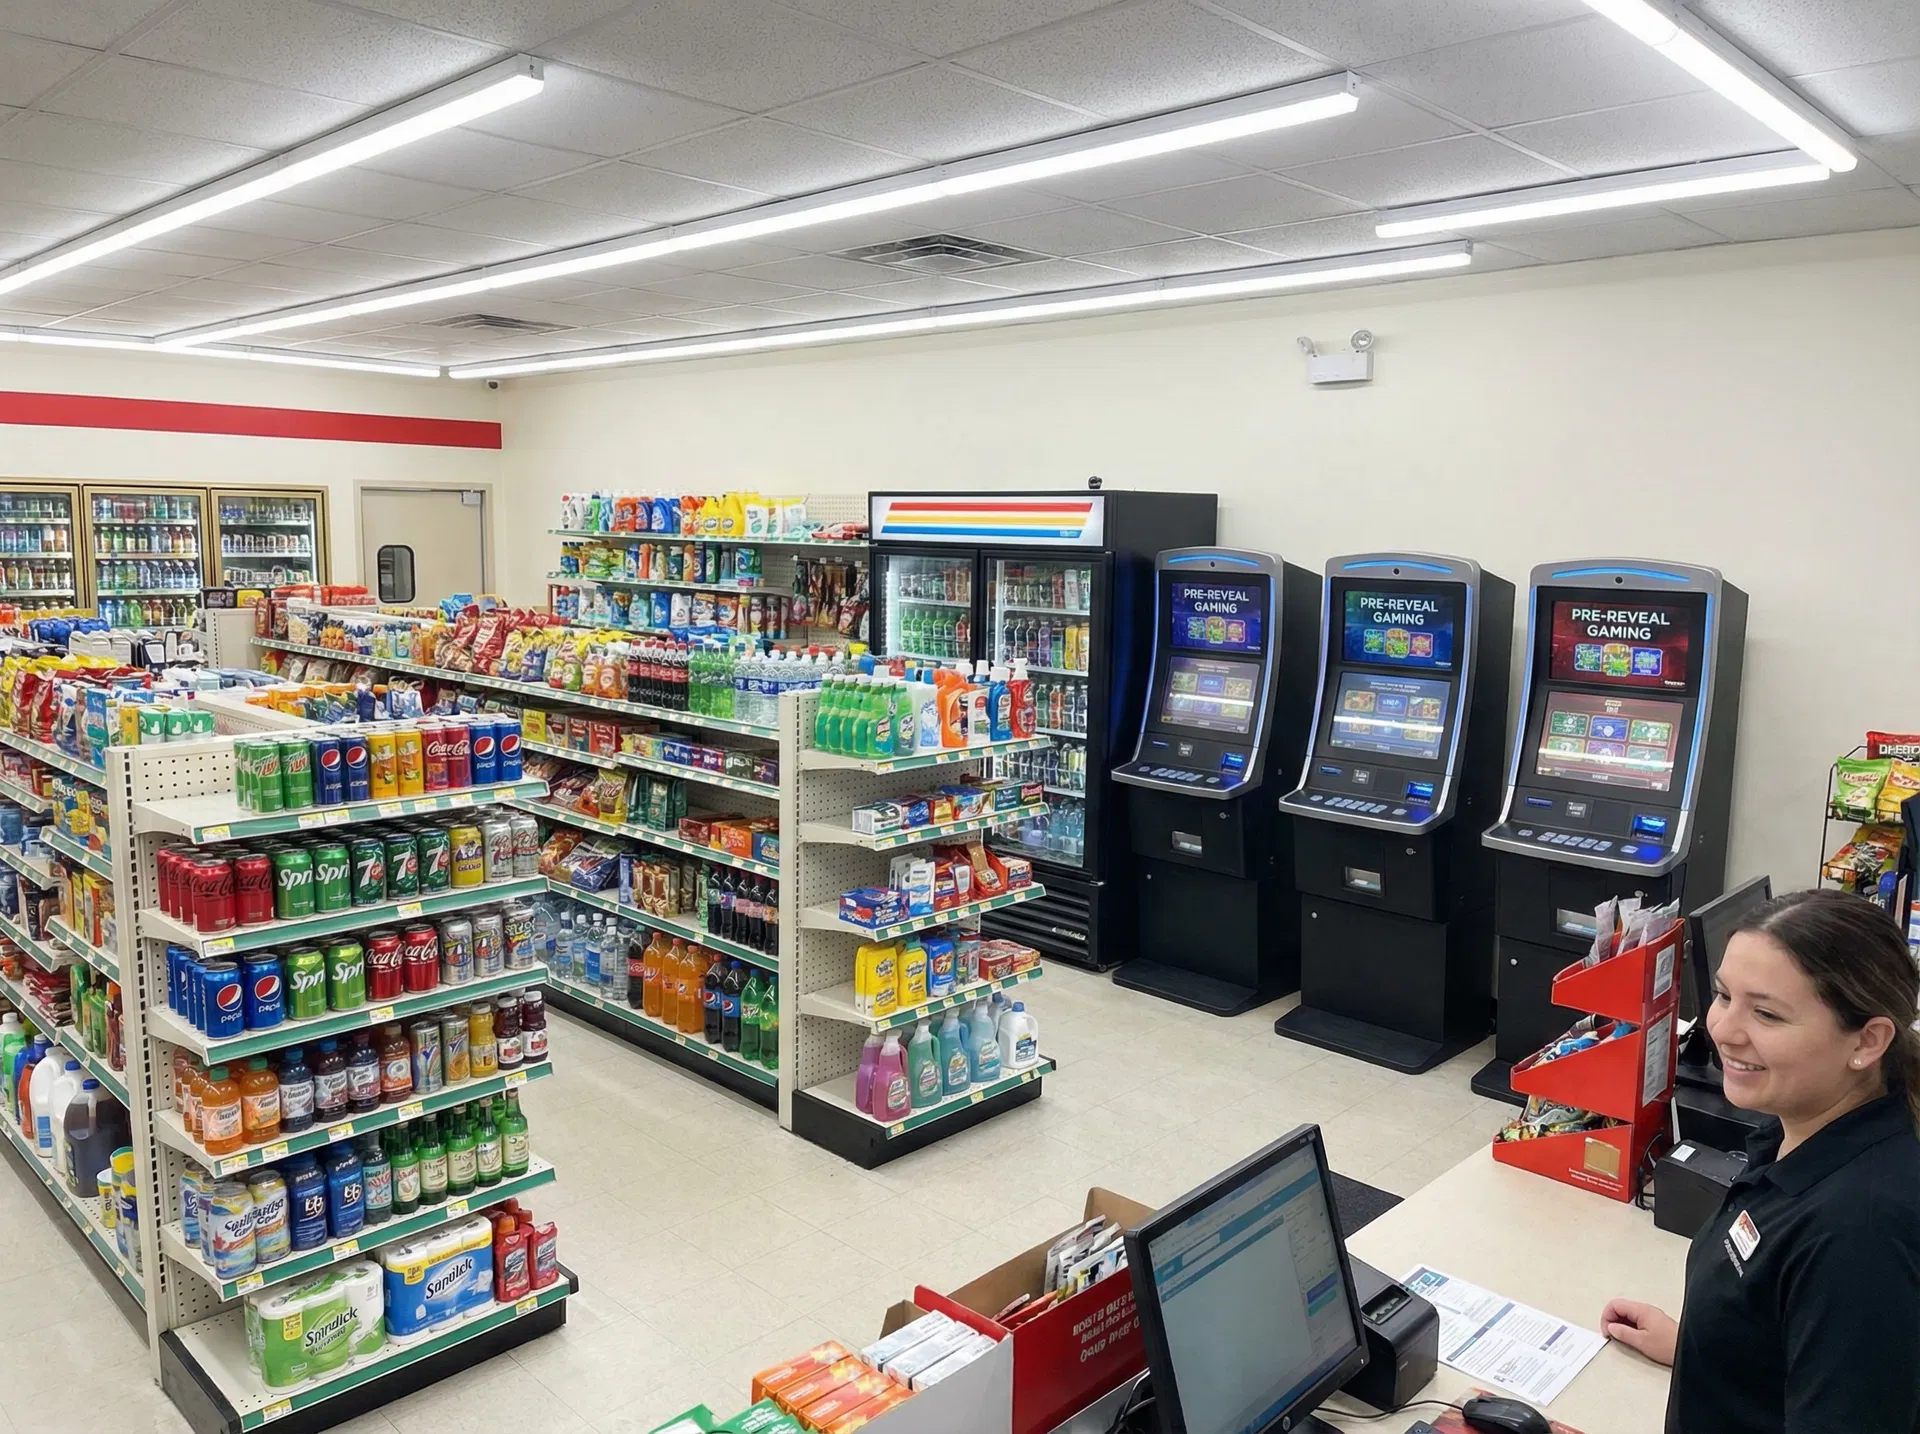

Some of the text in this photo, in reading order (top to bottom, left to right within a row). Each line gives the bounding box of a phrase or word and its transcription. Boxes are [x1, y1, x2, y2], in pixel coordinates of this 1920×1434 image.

[1184, 588, 1249, 601] PRE-REVEAL
[1194, 602, 1237, 614] GAMING
[1360, 597, 1439, 612] PRE-REVEAL
[1373, 612, 1425, 625] GAMING
[1571, 608, 1670, 625] PRE-REVEAL
[1586, 625, 1651, 640] GAMING
